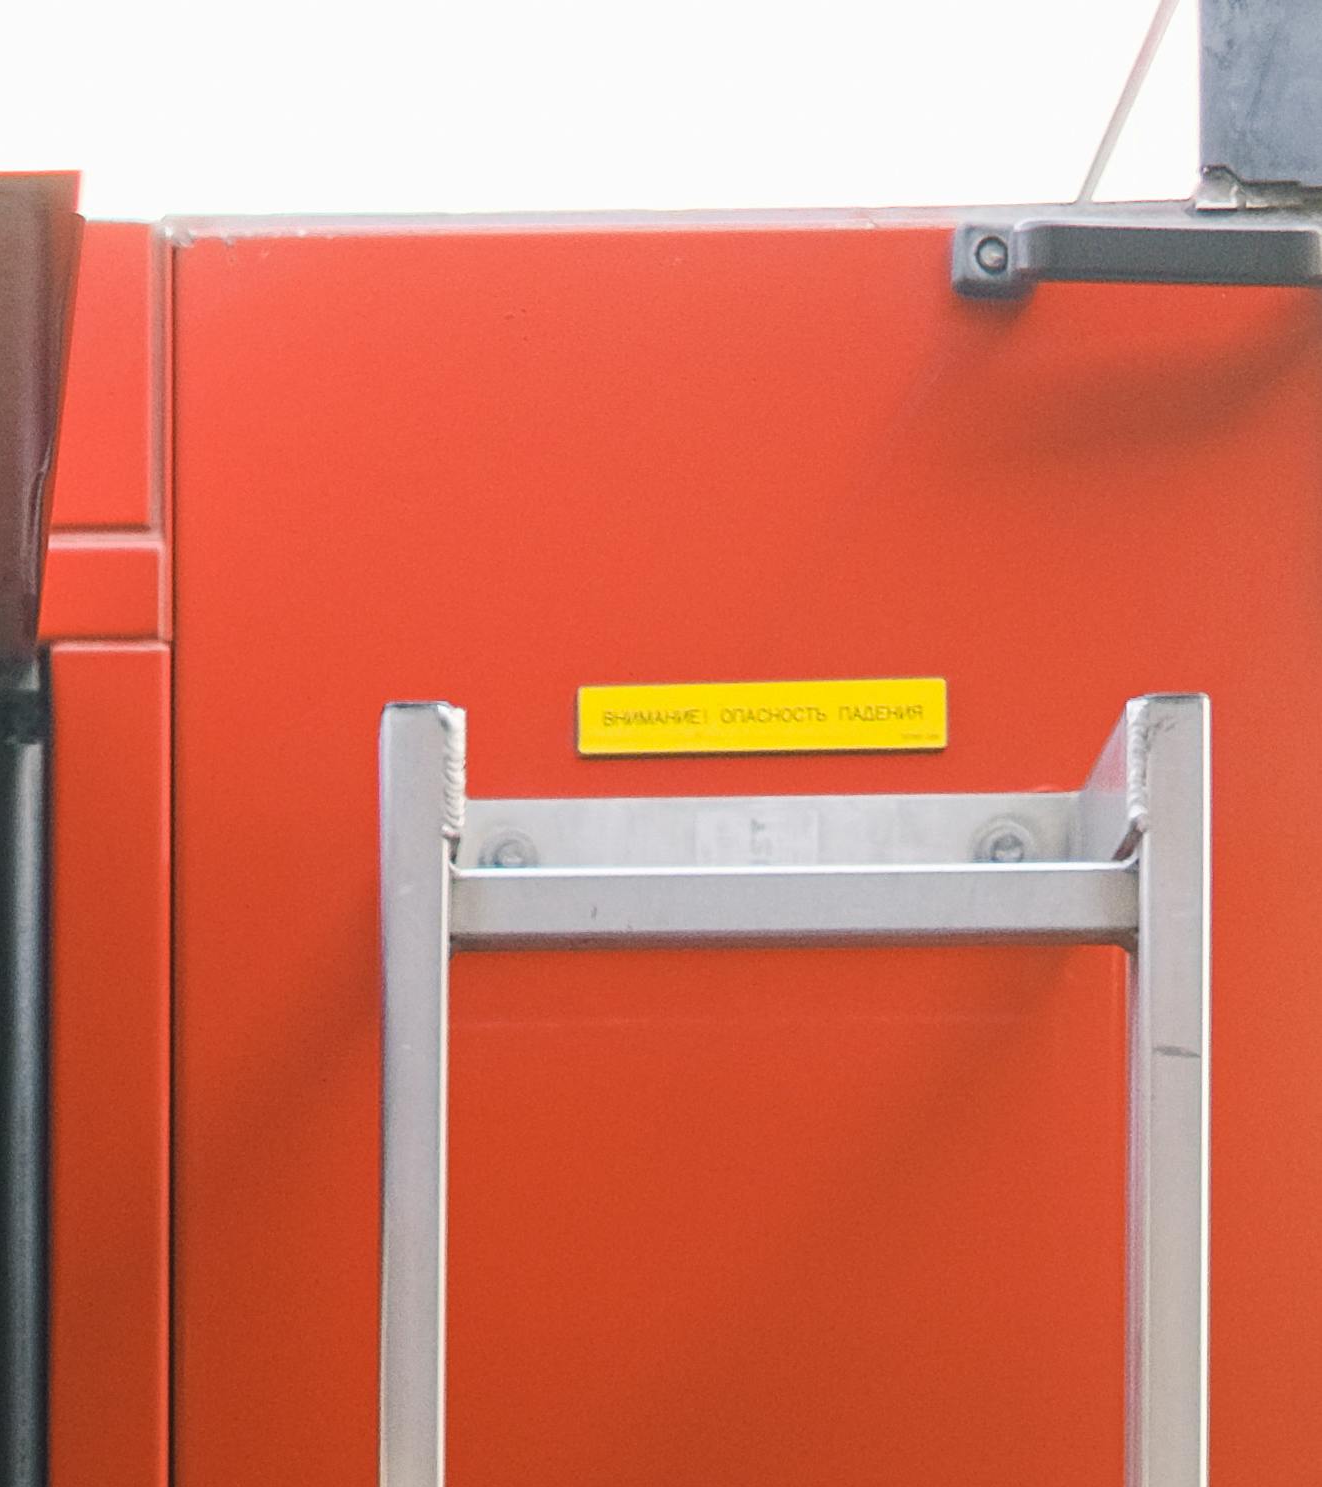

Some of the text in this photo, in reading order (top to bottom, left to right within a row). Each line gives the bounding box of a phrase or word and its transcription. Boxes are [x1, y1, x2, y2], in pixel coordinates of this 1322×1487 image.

[603, 705, 924, 728] ВНИМАНИЕ! ОПАСНОСТЬ ПАДЕНИЯ
